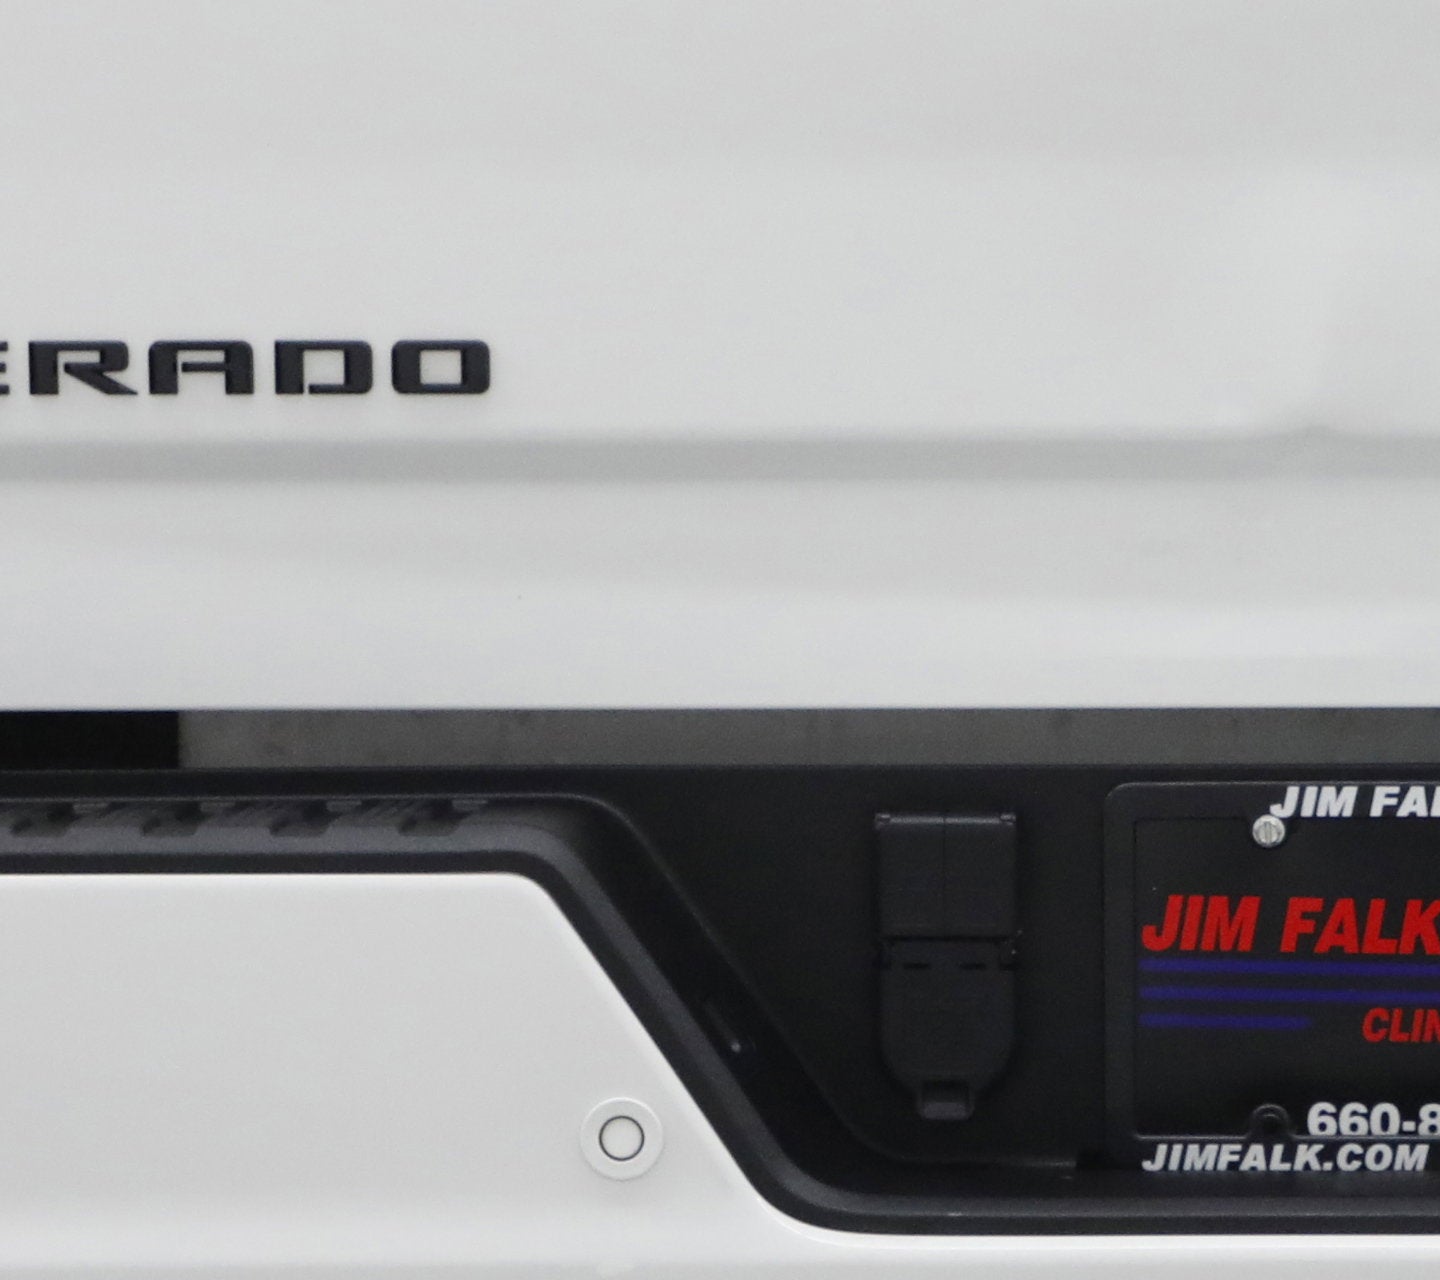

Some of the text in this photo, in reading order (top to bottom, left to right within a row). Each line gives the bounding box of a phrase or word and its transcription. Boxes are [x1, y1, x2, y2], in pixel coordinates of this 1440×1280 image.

[1269, 785, 1358, 818] JIM
[1141, 894, 1260, 952] JIM
[1141, 1143, 1430, 1171] JIMFALK.COM
